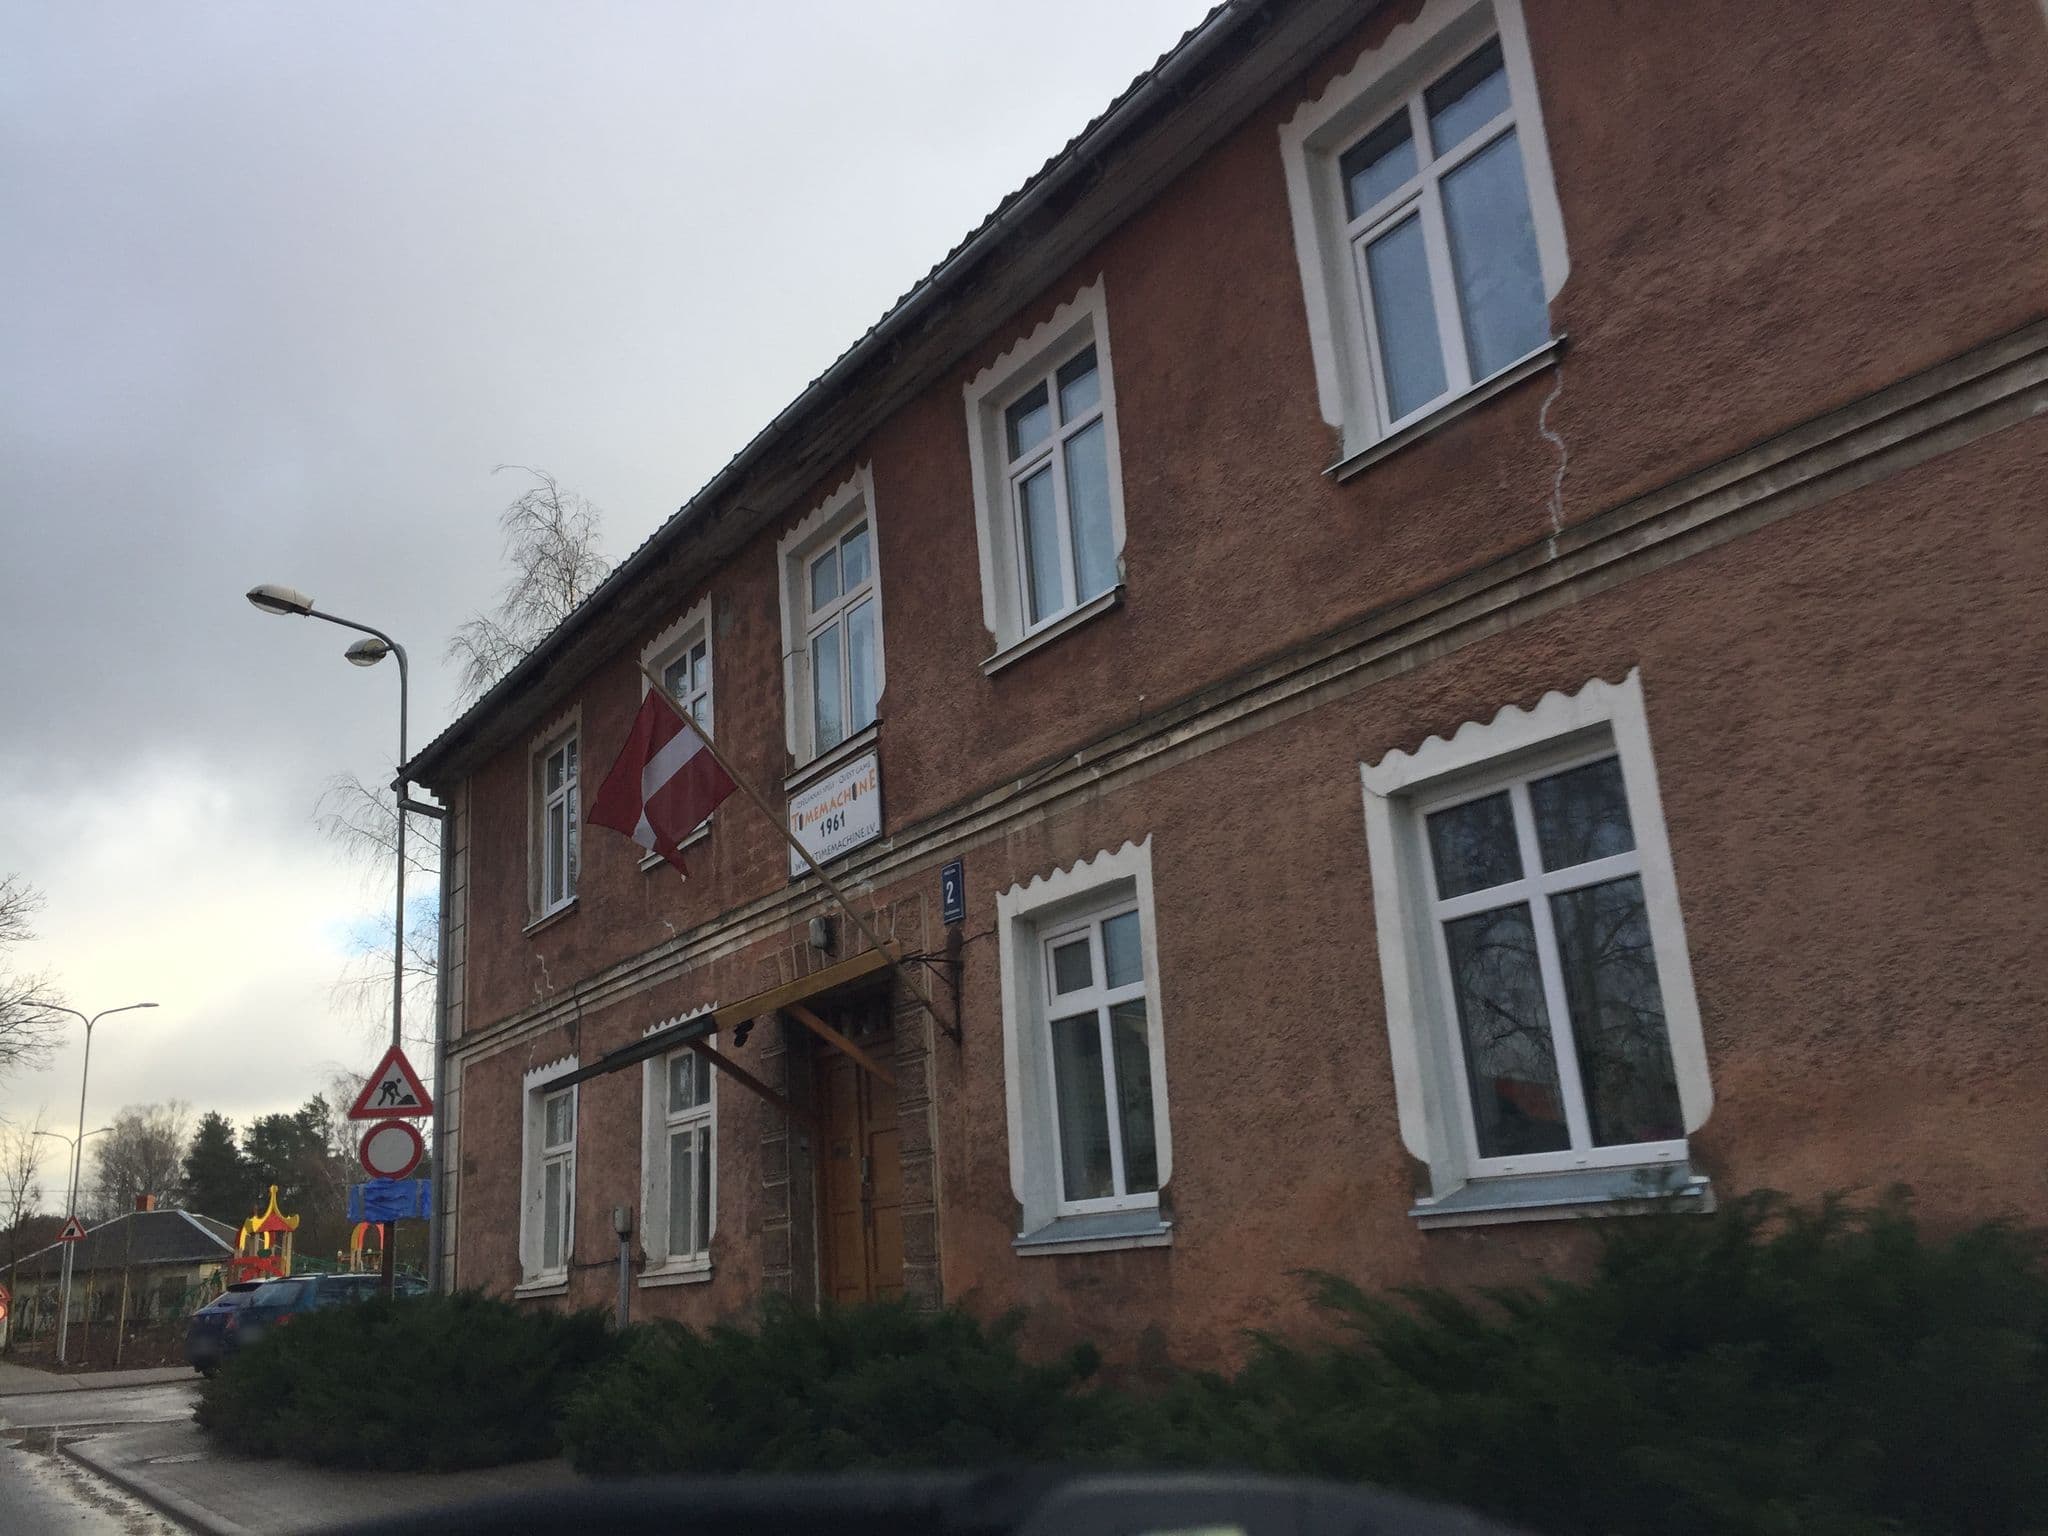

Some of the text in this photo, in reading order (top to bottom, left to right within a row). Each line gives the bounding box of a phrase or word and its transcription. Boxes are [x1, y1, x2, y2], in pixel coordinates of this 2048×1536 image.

[791, 768, 876, 832] TIMEMACHINE
[820, 810, 845, 838] 1961
[946, 880, 954, 904] 2
